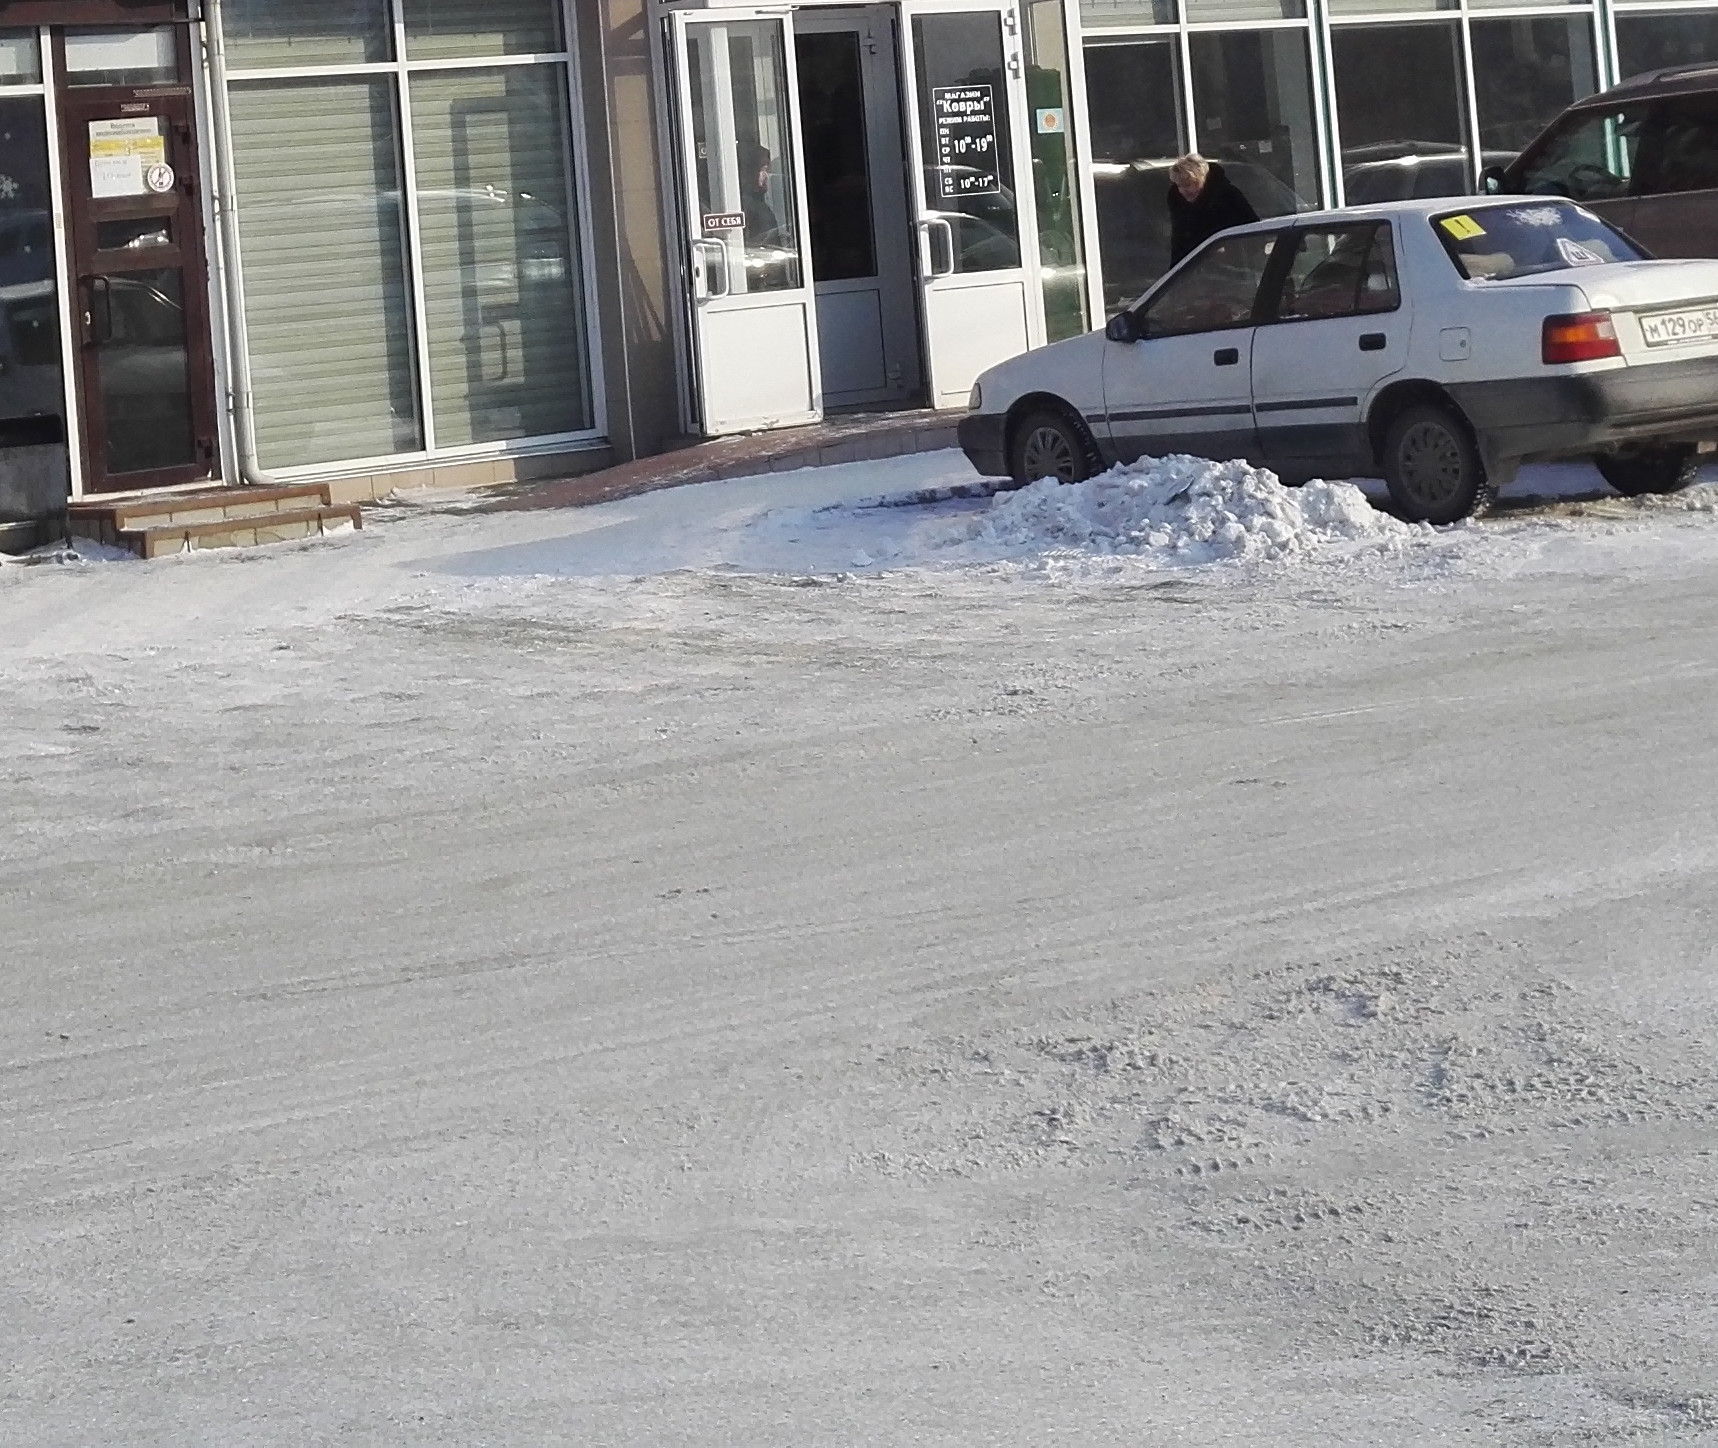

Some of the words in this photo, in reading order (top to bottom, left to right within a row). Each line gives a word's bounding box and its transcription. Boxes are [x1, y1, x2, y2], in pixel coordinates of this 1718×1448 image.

[944, 91, 981, 99] МАГАЗИН
[708, 217, 720, 227] ОТ
[721, 216, 742, 226] СЕБЯ
